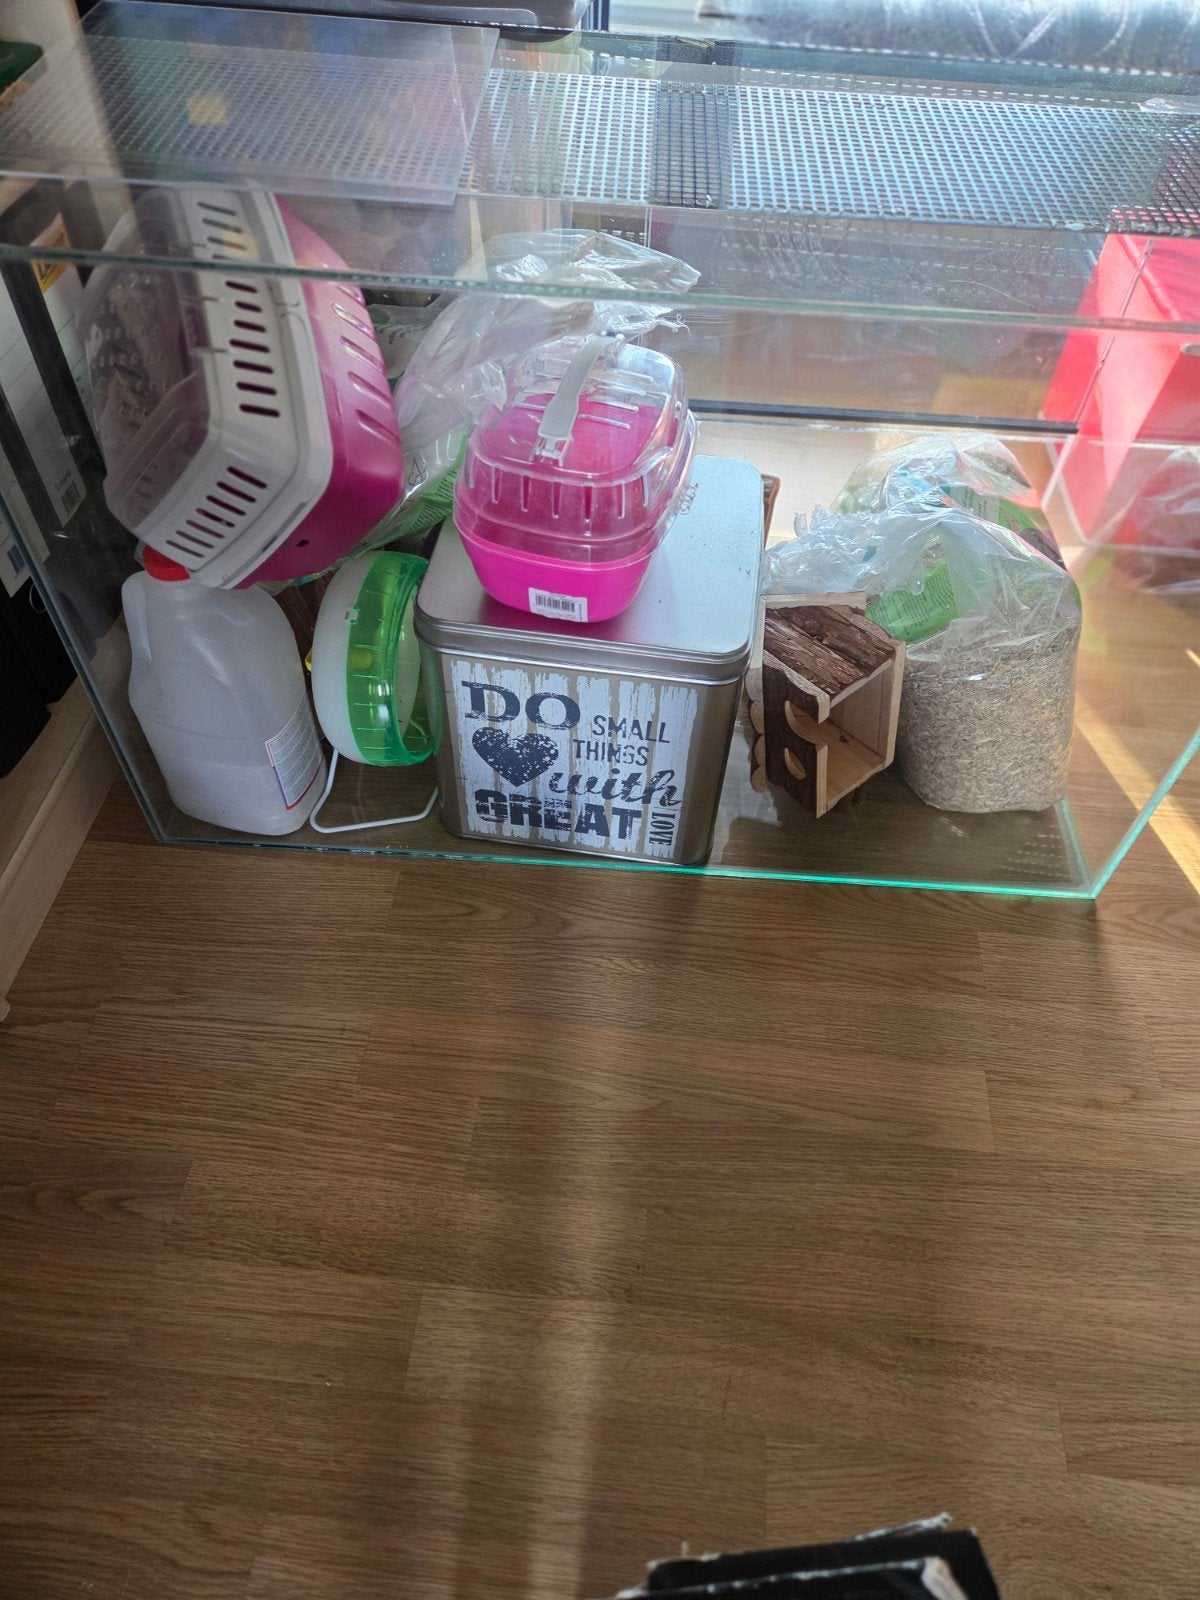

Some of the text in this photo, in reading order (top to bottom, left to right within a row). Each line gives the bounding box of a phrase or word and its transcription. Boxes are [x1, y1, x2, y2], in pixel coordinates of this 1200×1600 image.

[461, 680, 581, 730] DO
[592, 715, 670, 743] SMALL
[573, 739, 650, 766] THINGS
[549, 768, 683, 807] with
[474, 789, 642, 840] GREAT
[649, 811, 676, 846] LOVE
